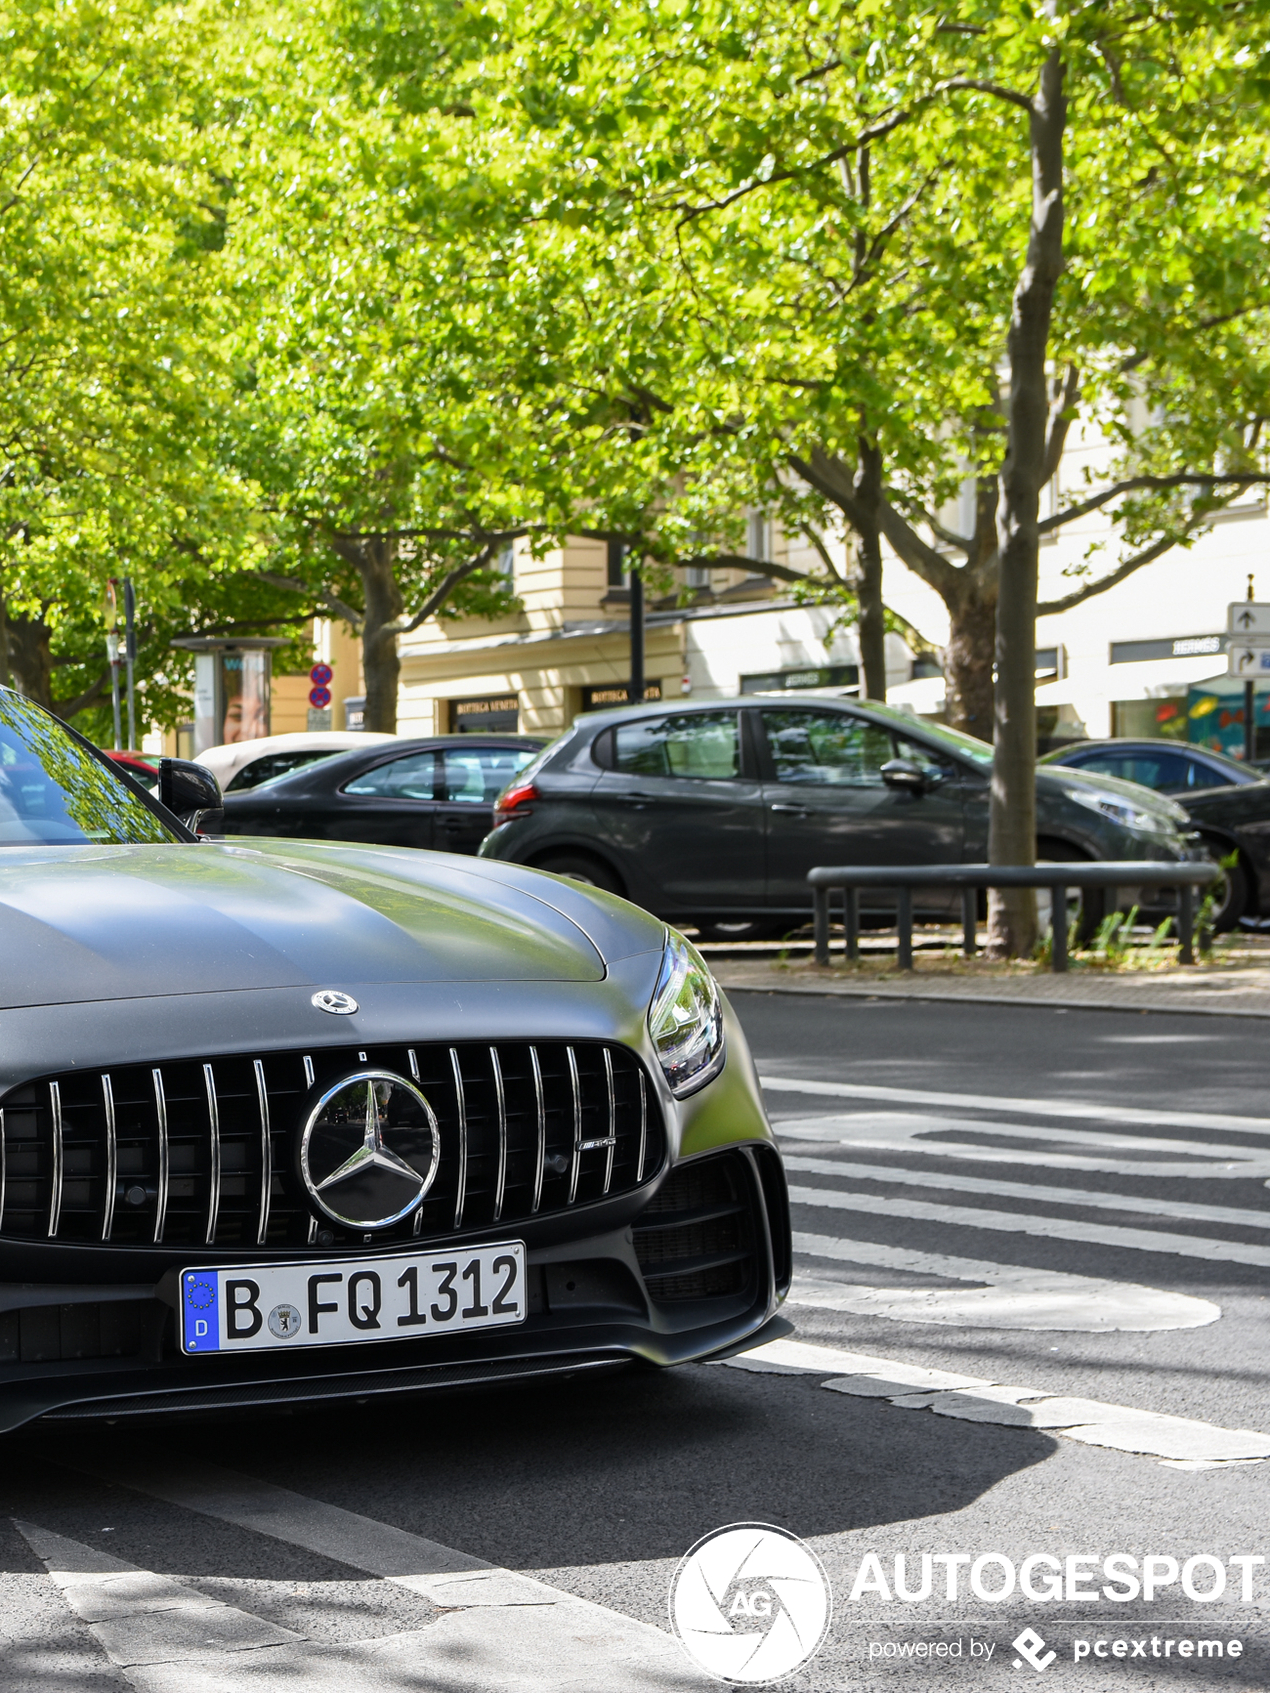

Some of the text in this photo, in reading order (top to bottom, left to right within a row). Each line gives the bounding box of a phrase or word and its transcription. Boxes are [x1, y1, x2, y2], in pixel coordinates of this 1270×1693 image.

[457, 699, 518, 715] BOTTEGA VENETA
[225, 1279, 263, 1340] B
[308, 1270, 381, 1334] FQ
[397, 1255, 518, 1327] 1312
[195, 1319, 208, 1337] D
